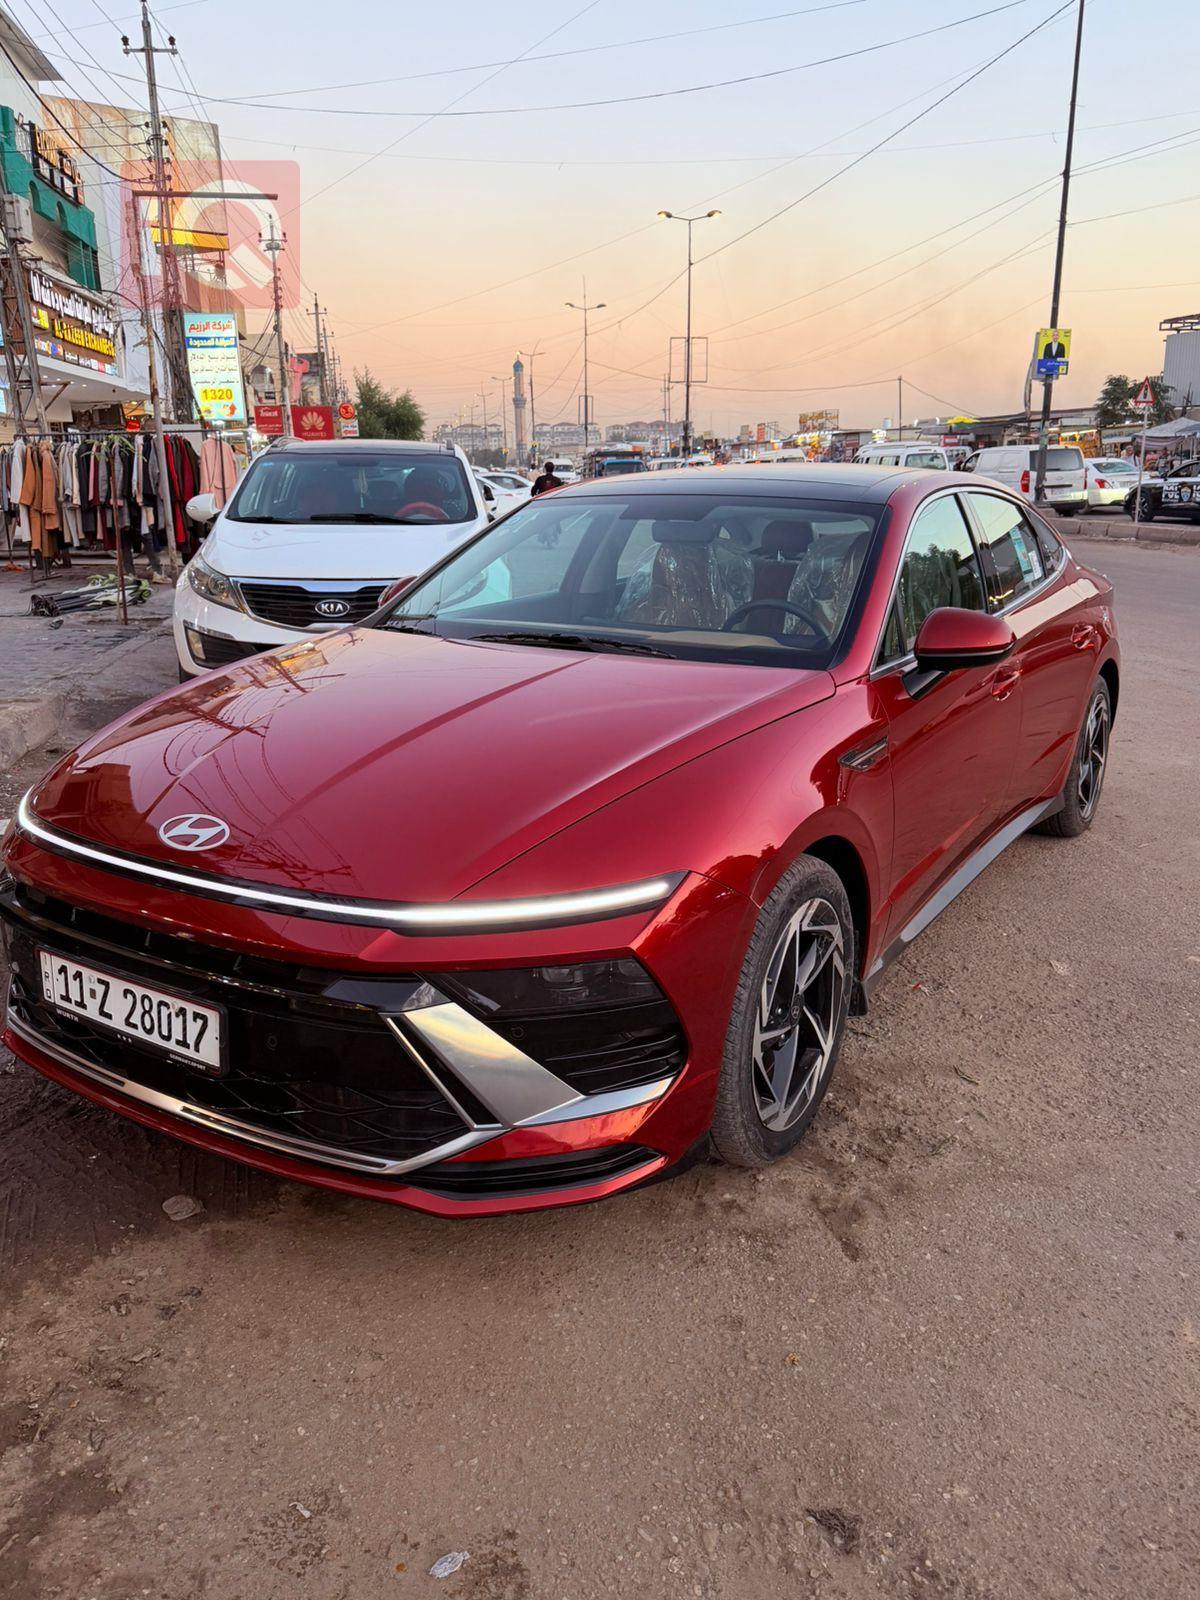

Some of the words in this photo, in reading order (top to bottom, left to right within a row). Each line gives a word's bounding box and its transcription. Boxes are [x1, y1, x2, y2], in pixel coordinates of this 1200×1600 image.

[202, 388, 233, 401] 1320
[321, 603, 344, 613] KIA
[122, 987, 209, 1054] 28017
